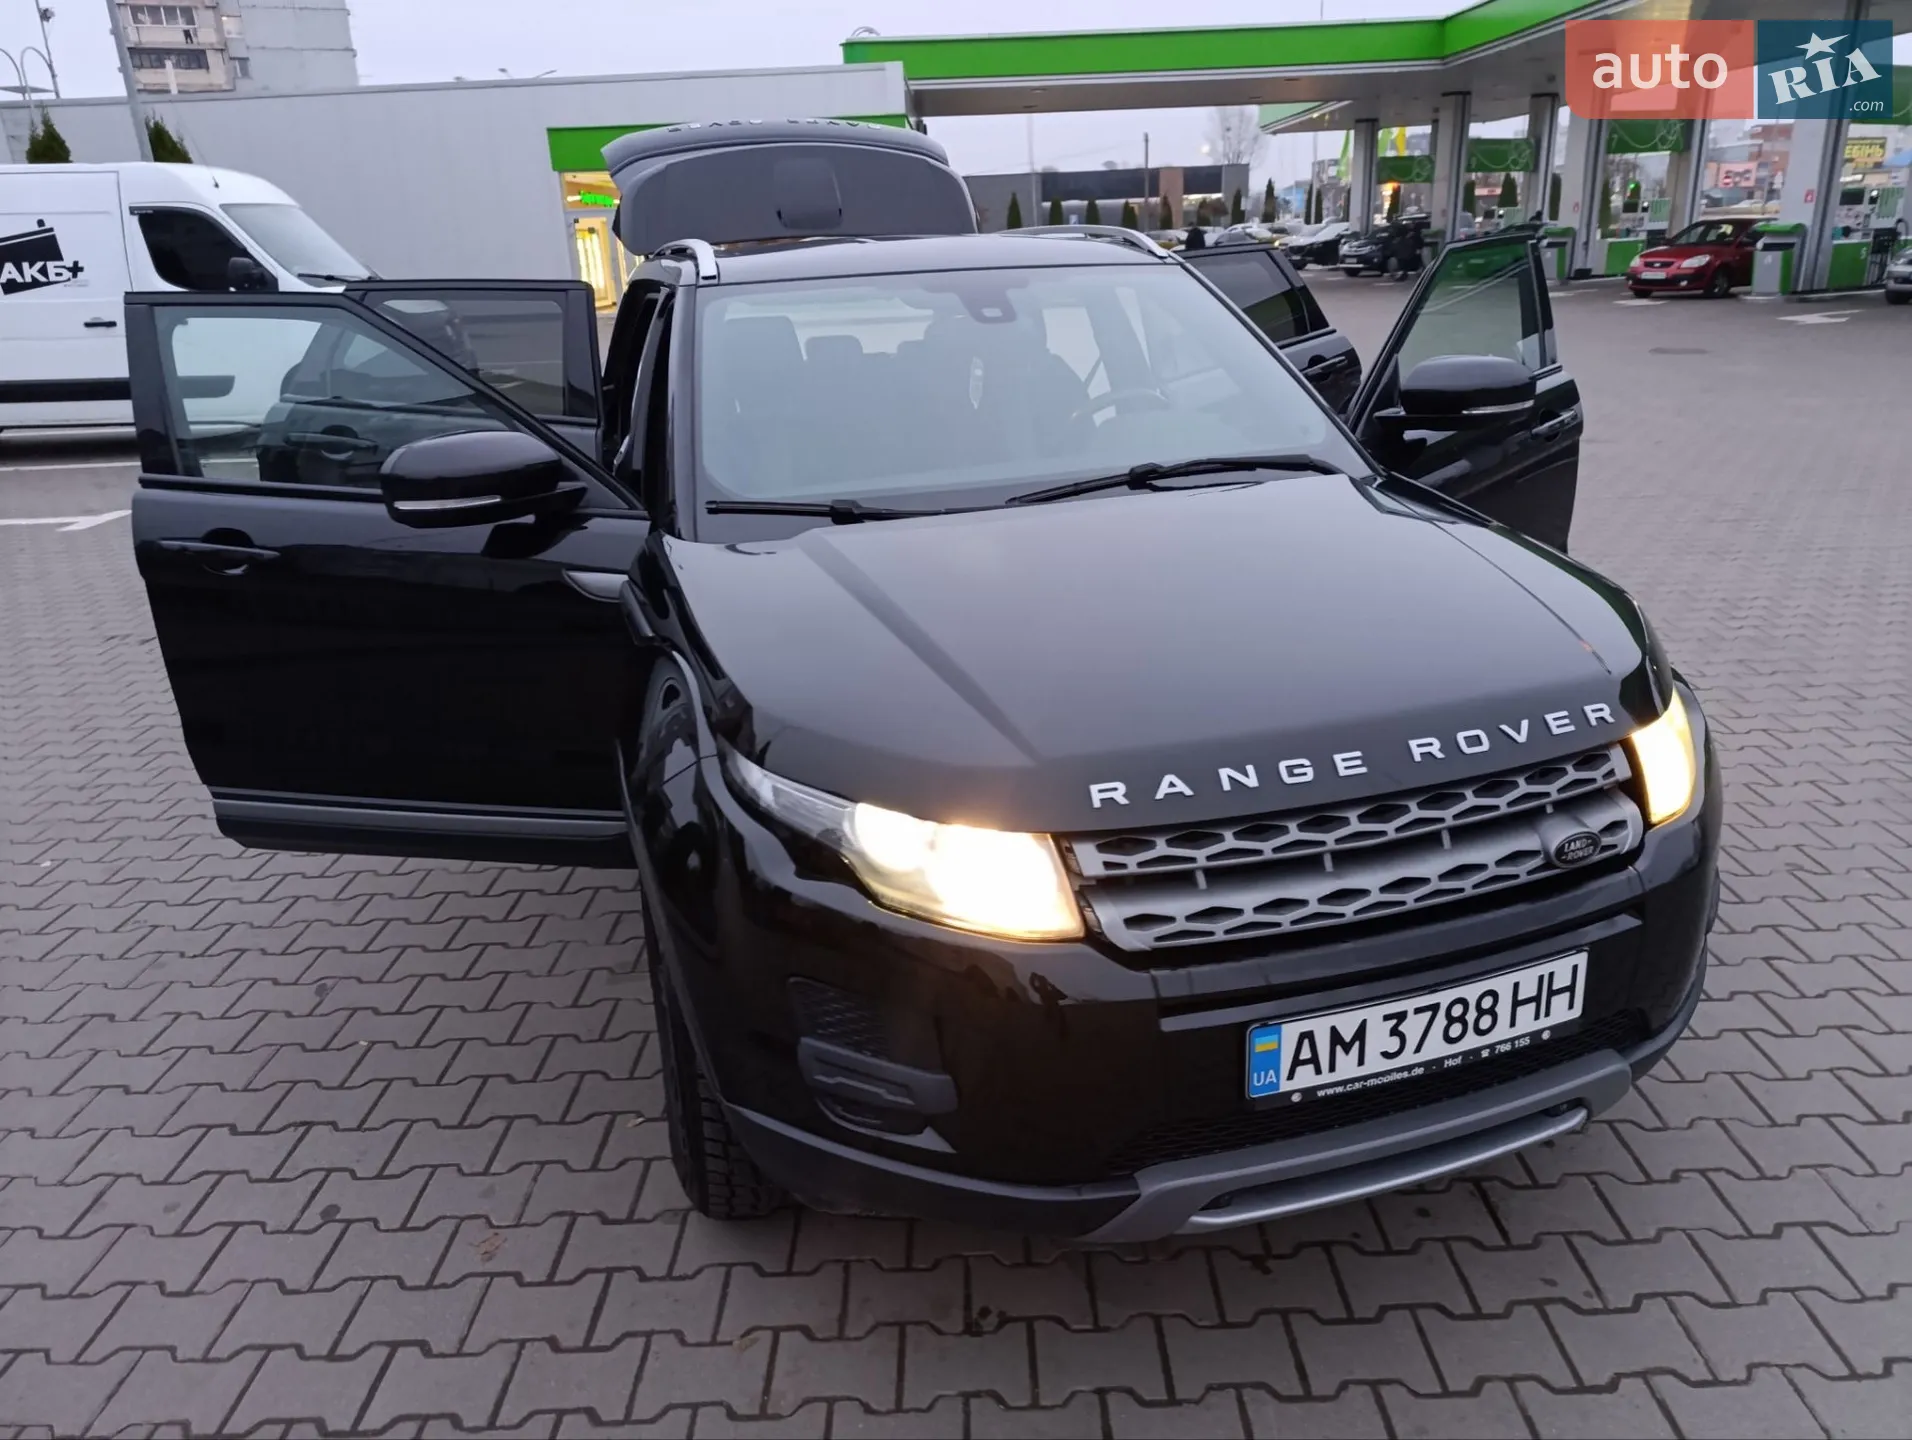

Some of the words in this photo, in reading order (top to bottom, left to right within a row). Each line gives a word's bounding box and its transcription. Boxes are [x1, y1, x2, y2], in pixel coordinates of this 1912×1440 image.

[1088, 750, 1368, 809] RANGE
[1407, 702, 1616, 762] ROVER
[1285, 1018, 1368, 1081] AM
[1379, 988, 1500, 1060] 3788
[1509, 963, 1579, 1029] HH
[1443, 1055, 1463, 1068] Hof
[1494, 1042, 1512, 1054] 766
[1514, 1036, 1531, 1048] 155
[1253, 1069, 1277, 1087] UA
